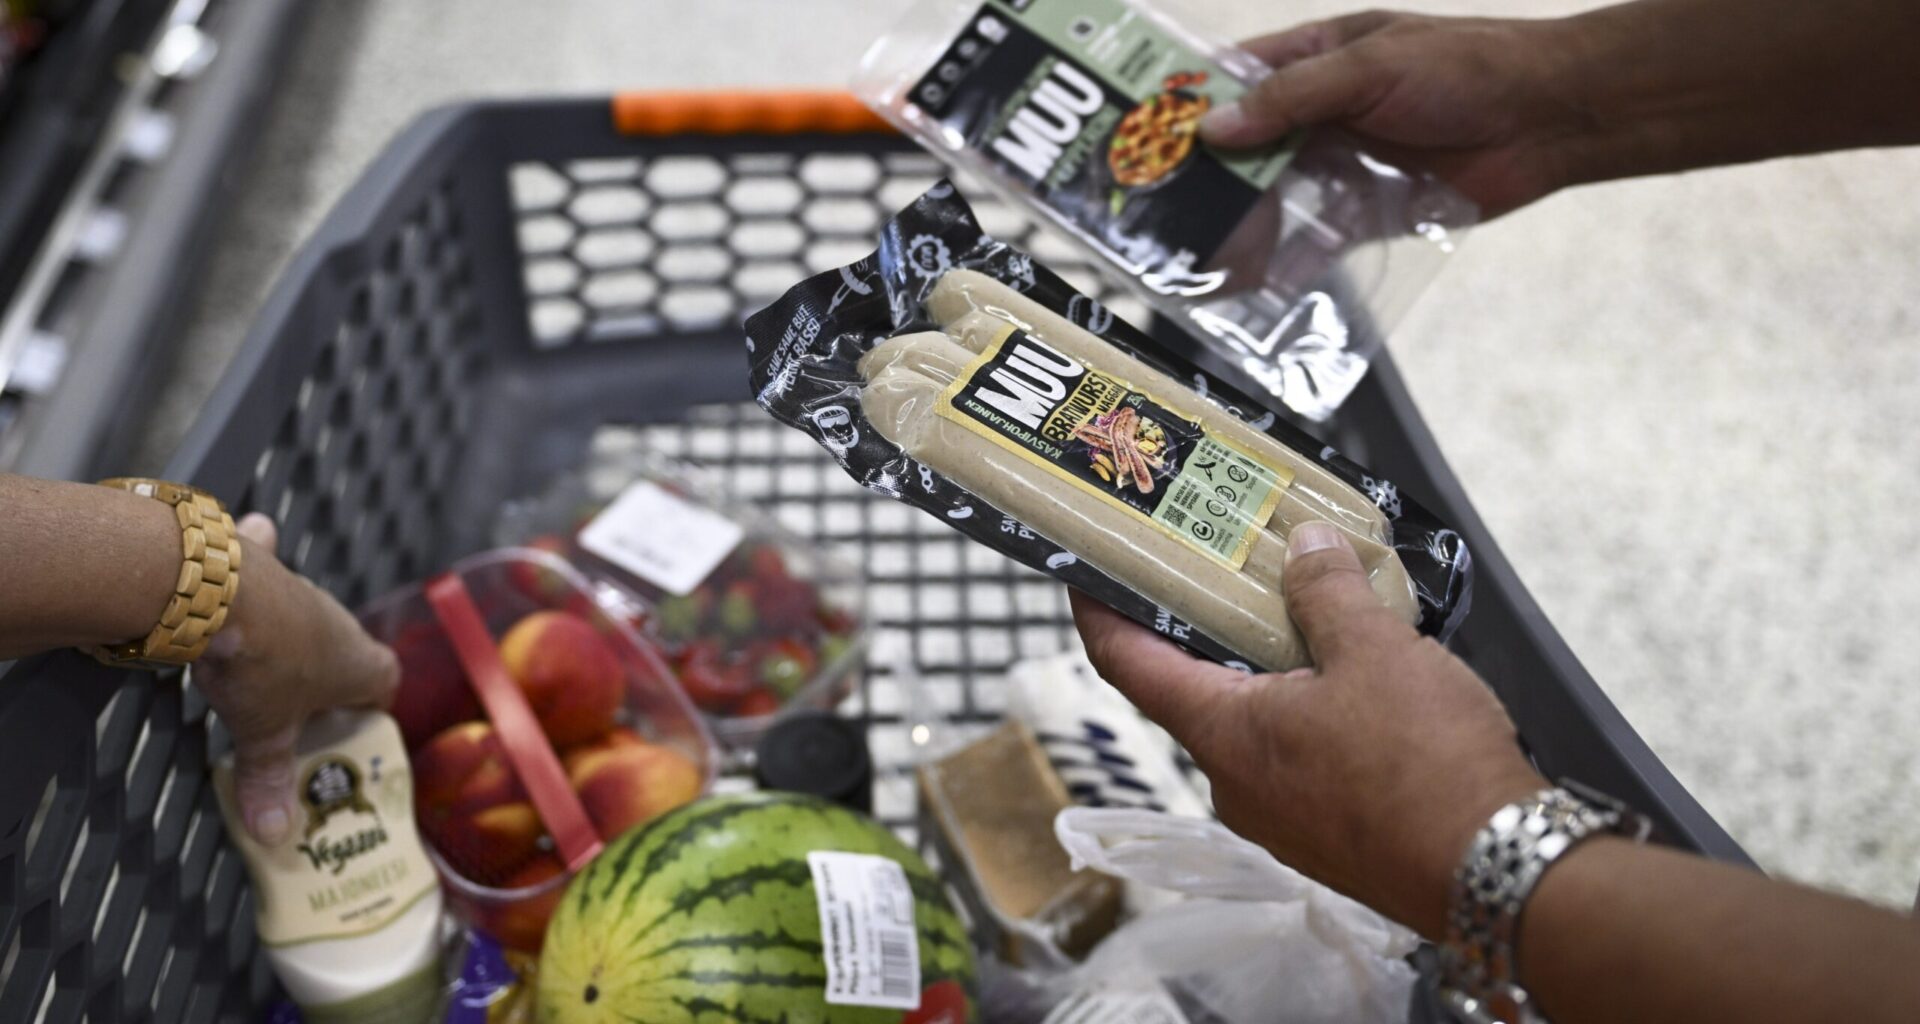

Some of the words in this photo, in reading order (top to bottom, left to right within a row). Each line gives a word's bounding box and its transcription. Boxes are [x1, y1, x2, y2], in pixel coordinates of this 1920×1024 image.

[993, 63, 1103, 179] MUU
[766, 349, 784, 381] SAME
[776, 326, 797, 355] SAME
[791, 303, 810, 330] BUT
[792, 316, 821, 358] BASED
[974, 334, 1084, 430] MUU
[1044, 373, 1108, 441] BRATWURST
[964, 399, 1063, 460] KASVIPOHJAINEN
